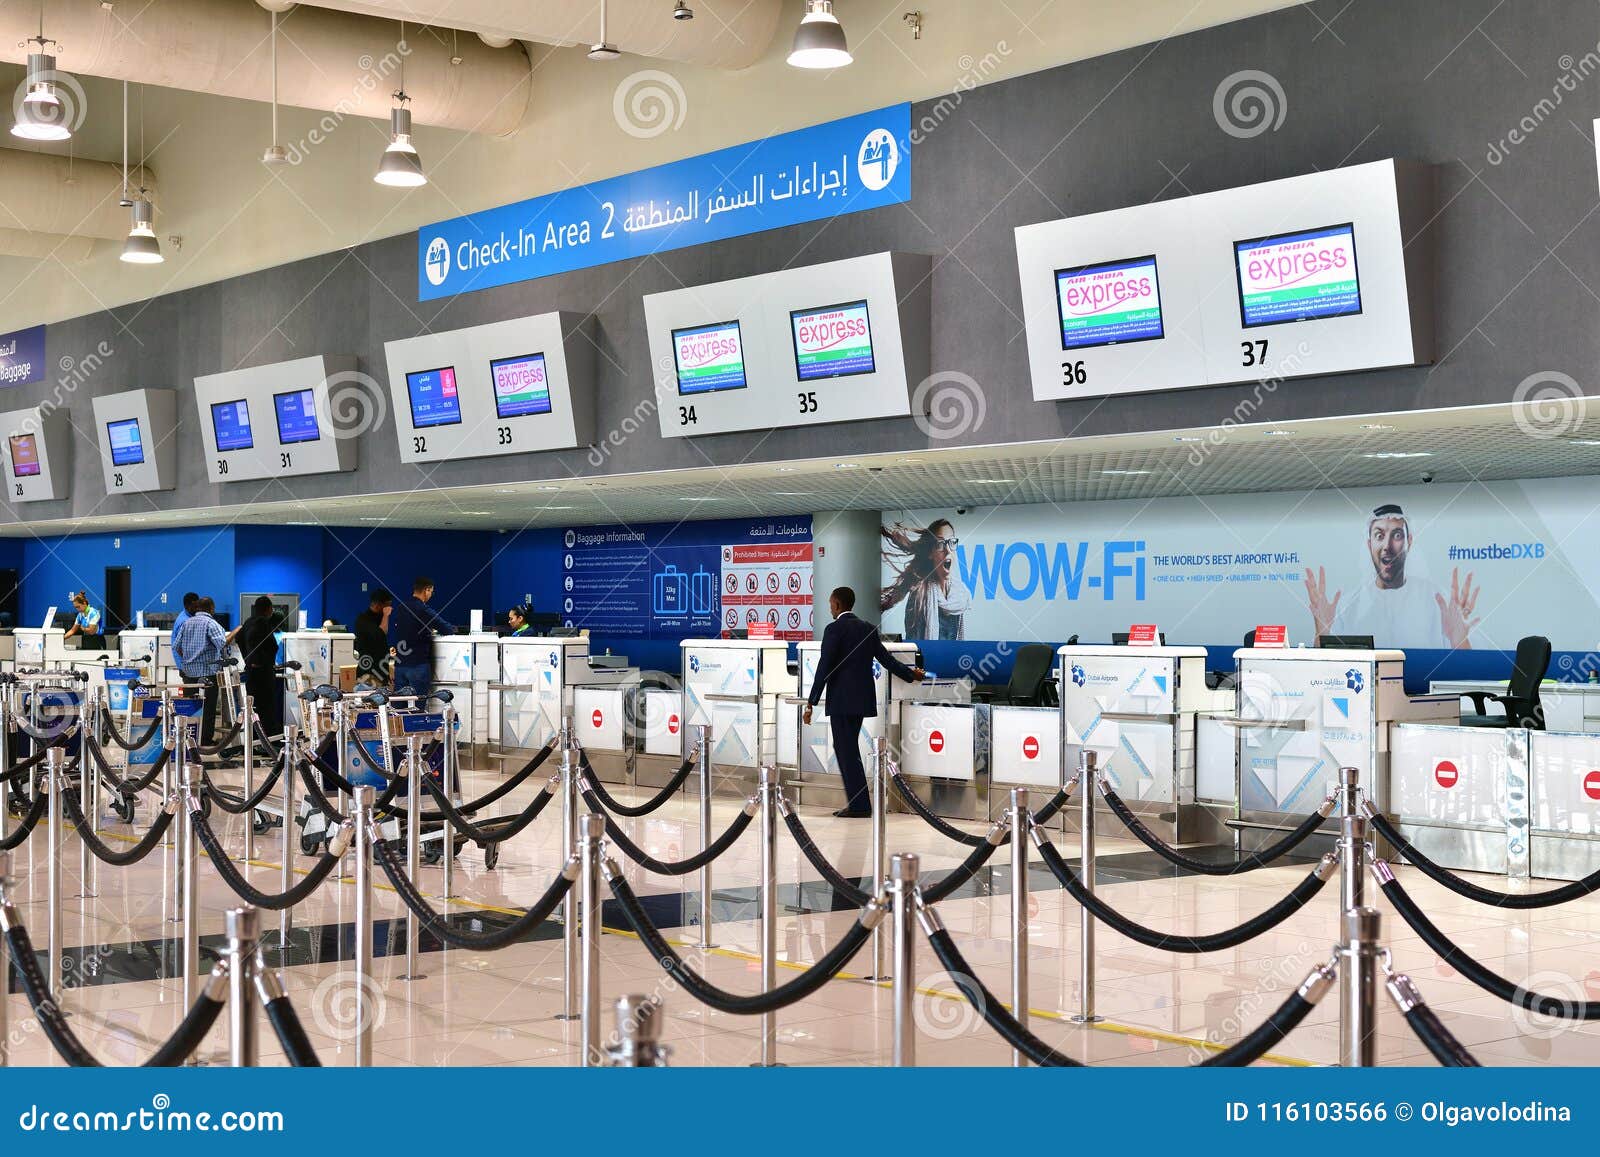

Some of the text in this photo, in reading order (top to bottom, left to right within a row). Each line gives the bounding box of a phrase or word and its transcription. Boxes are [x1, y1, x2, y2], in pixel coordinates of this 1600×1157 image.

[623, 154, 848, 232] إجراءات السفر المنطقة
[457, 202, 615, 271] Check-In Area 2
[1249, 241, 1315, 257] AIR INDIA
[1249, 247, 1347, 283] express
[1067, 271, 1124, 285] AIR INDIA
[1067, 278, 1151, 309] express
[799, 318, 866, 346] express
[680, 337, 737, 361] express
[1241, 340, 1268, 367] 37
[0, 362, 31, 382] Baggage
[498, 367, 543, 389] express
[1061, 360, 1087, 386] 36
[798, 391, 818, 414] 35
[680, 405, 697, 425] 34
[413, 436, 427, 453] 32
[498, 426, 512, 445] 33
[217, 460, 228, 474] 30
[280, 452, 291, 468] 31
[16, 483, 24, 496] 28
[114, 473, 123, 487] 29
[577, 531, 646, 545] Baggage Information
[775, 524, 808, 537] معلومات
[1153, 555, 1169, 565] THE
[1171, 554, 1210, 565] WORLD'S
[1212, 554, 1232, 565] BEST
[1234, 553, 1272, 564] AIRPORT
[1448, 543, 1545, 560] #mustbeDXB
[957, 541, 1146, 601] WOW-Fi
[1191, 574, 1223, 582] HIGH SPEED
[1285, 573, 1299, 581] FREE
